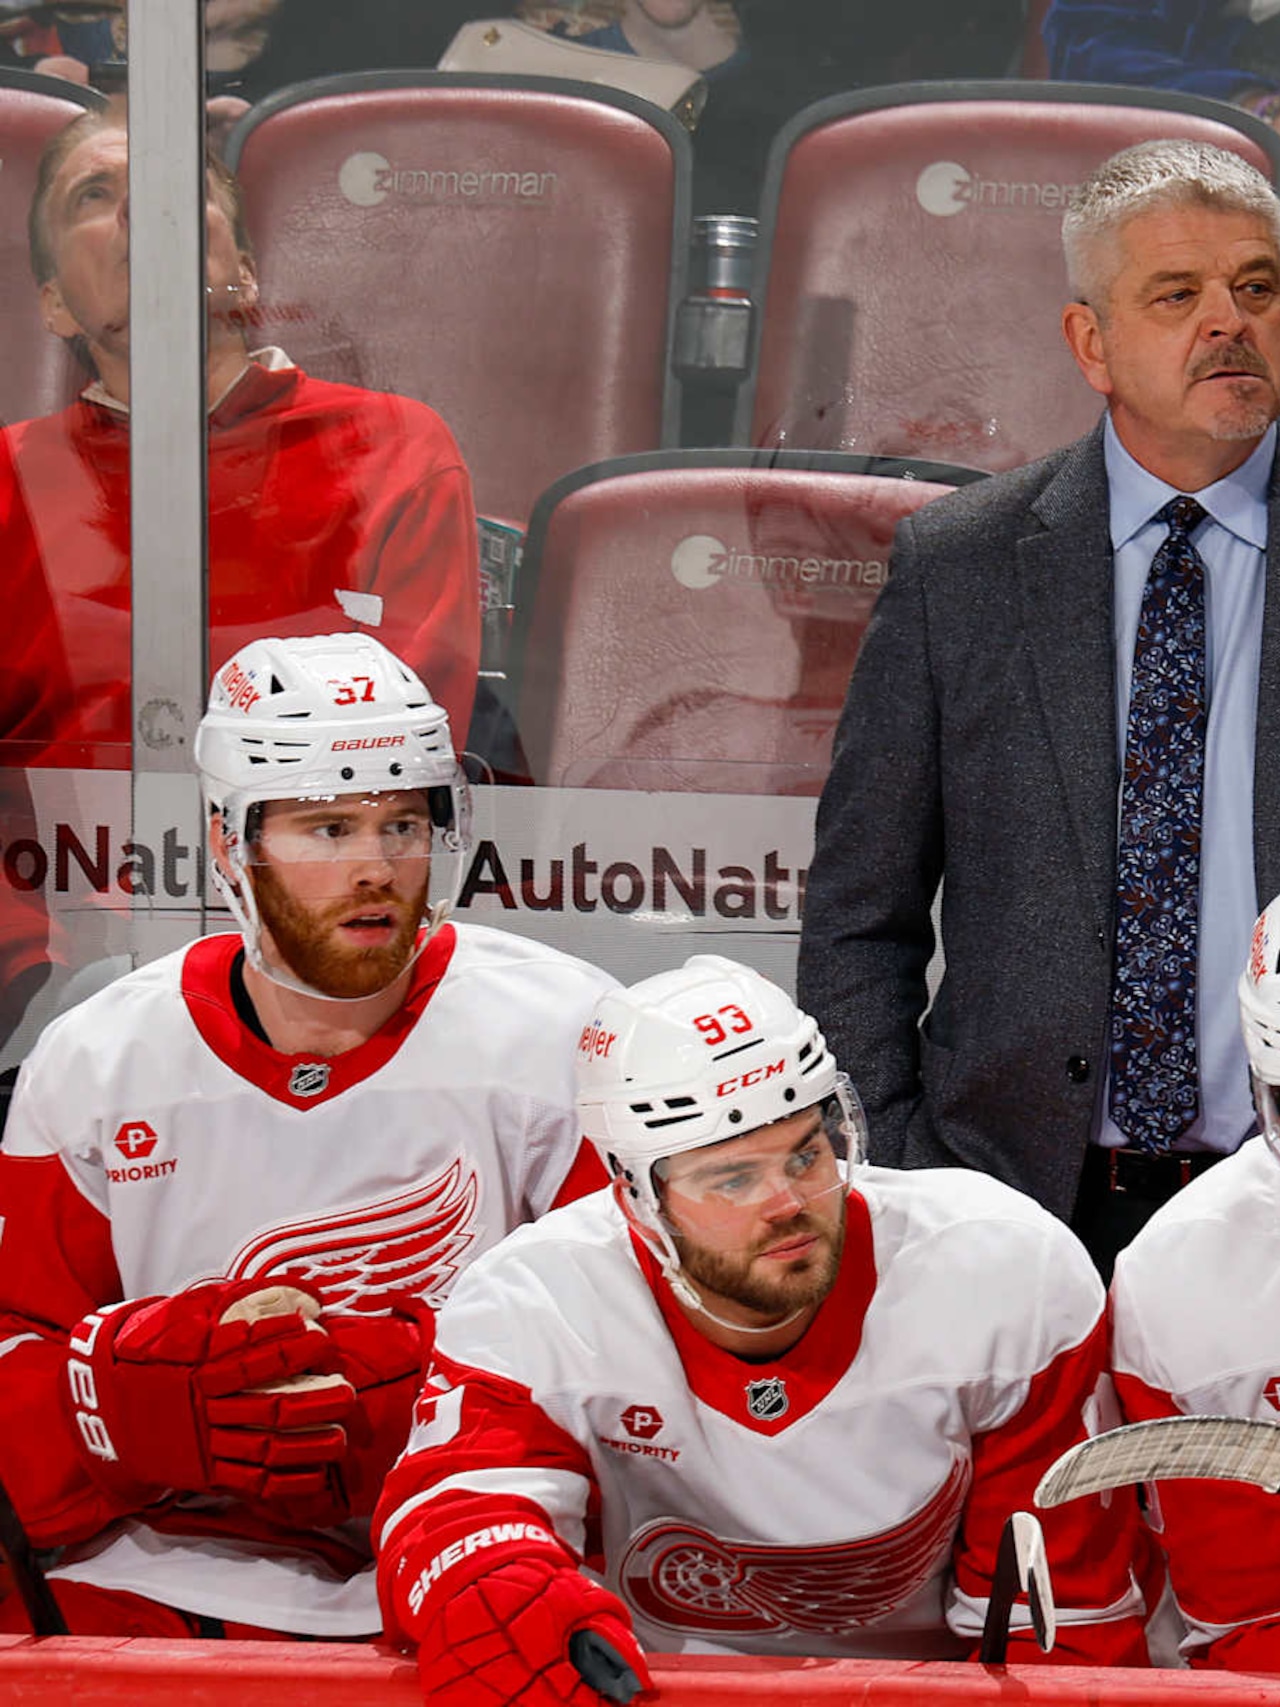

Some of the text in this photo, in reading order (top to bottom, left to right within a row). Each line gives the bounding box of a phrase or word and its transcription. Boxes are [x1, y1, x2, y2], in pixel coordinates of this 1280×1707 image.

[373, 165, 558, 196] zimmerman
[952, 173, 1080, 207] zimmer
[694, 1004, 752, 1046] 93
[716, 1059, 785, 1097] CCM
